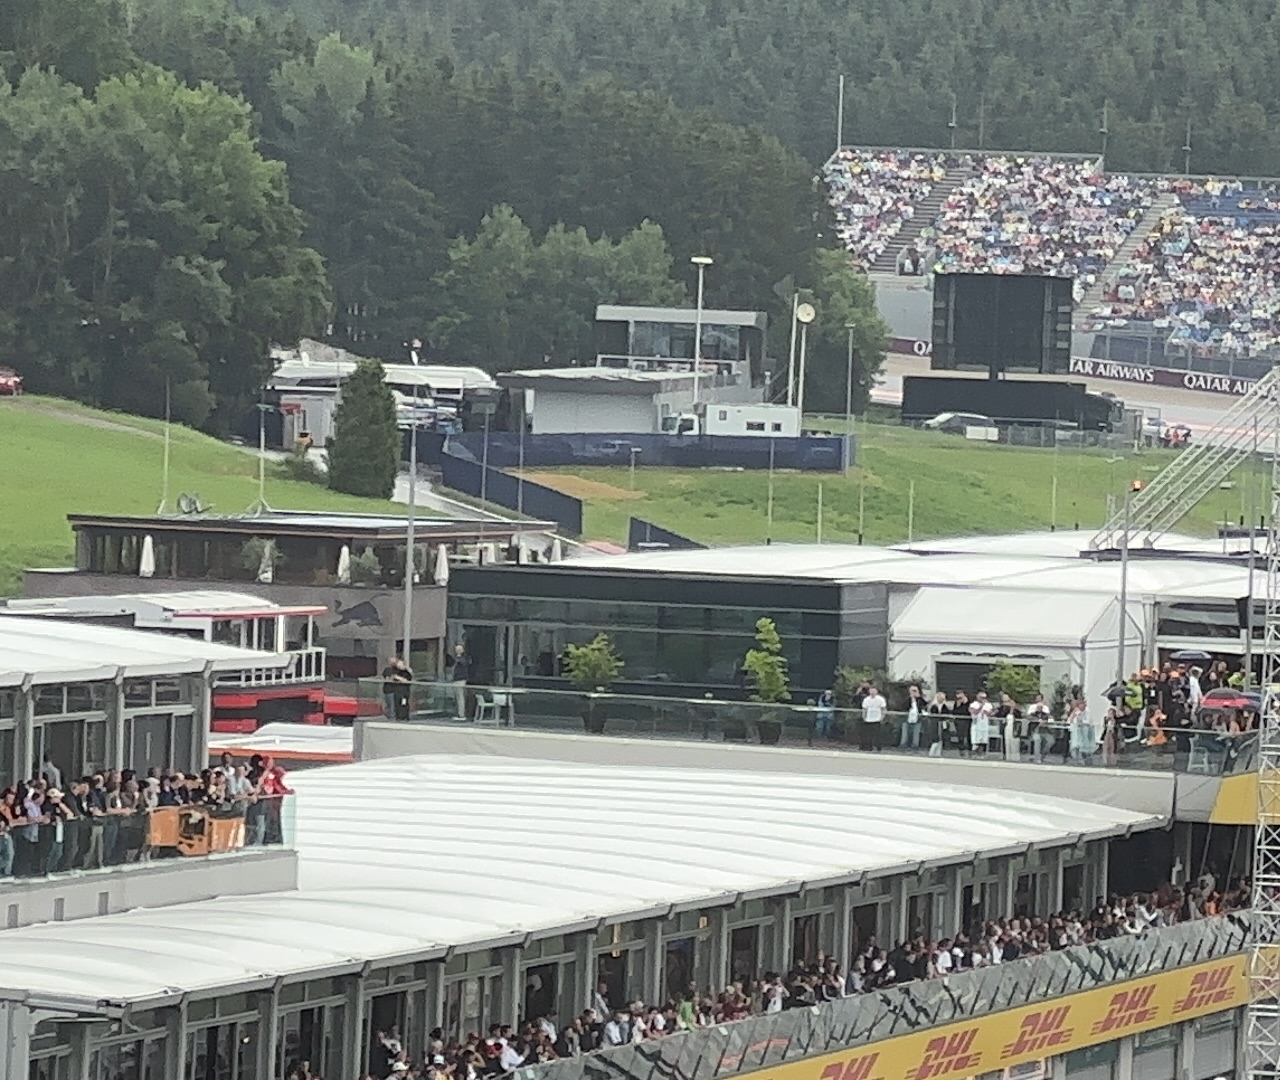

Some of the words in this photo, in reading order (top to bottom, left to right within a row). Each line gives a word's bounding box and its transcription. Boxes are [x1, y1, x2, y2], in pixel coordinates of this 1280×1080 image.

[1096, 359, 1154, 383] AIRWAYS
[1183, 373, 1230, 393] QATAR
[1092, 984, 1157, 1034] DHL
[1173, 965, 1235, 1013] DHL
[1002, 1005, 1073, 1059] DHL
